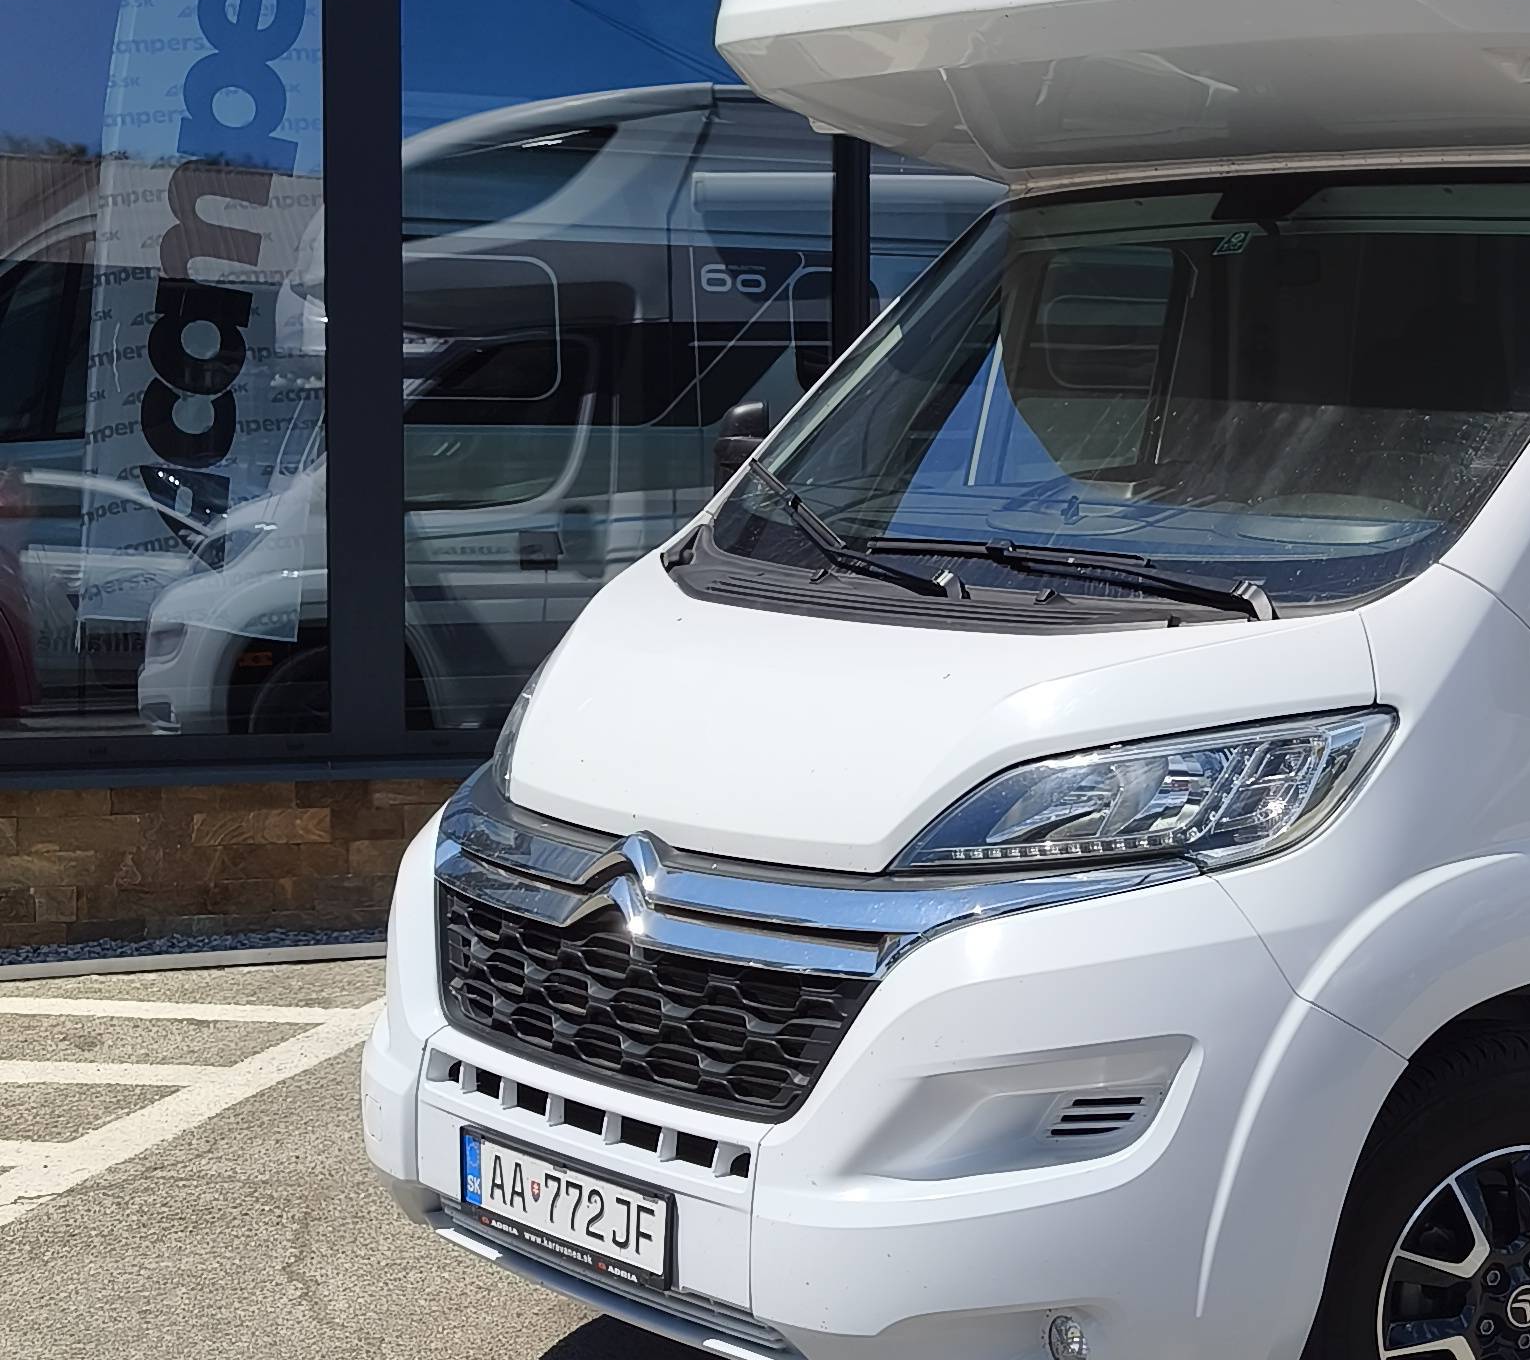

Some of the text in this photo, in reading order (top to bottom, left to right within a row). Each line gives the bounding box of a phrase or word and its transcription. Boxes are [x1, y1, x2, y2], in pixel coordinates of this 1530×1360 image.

[701, 264, 766, 293] 60
[467, 1174, 481, 1195] SK
[491, 1219, 519, 1236] ADRIA
[607, 1265, 638, 1283] ADRIA
